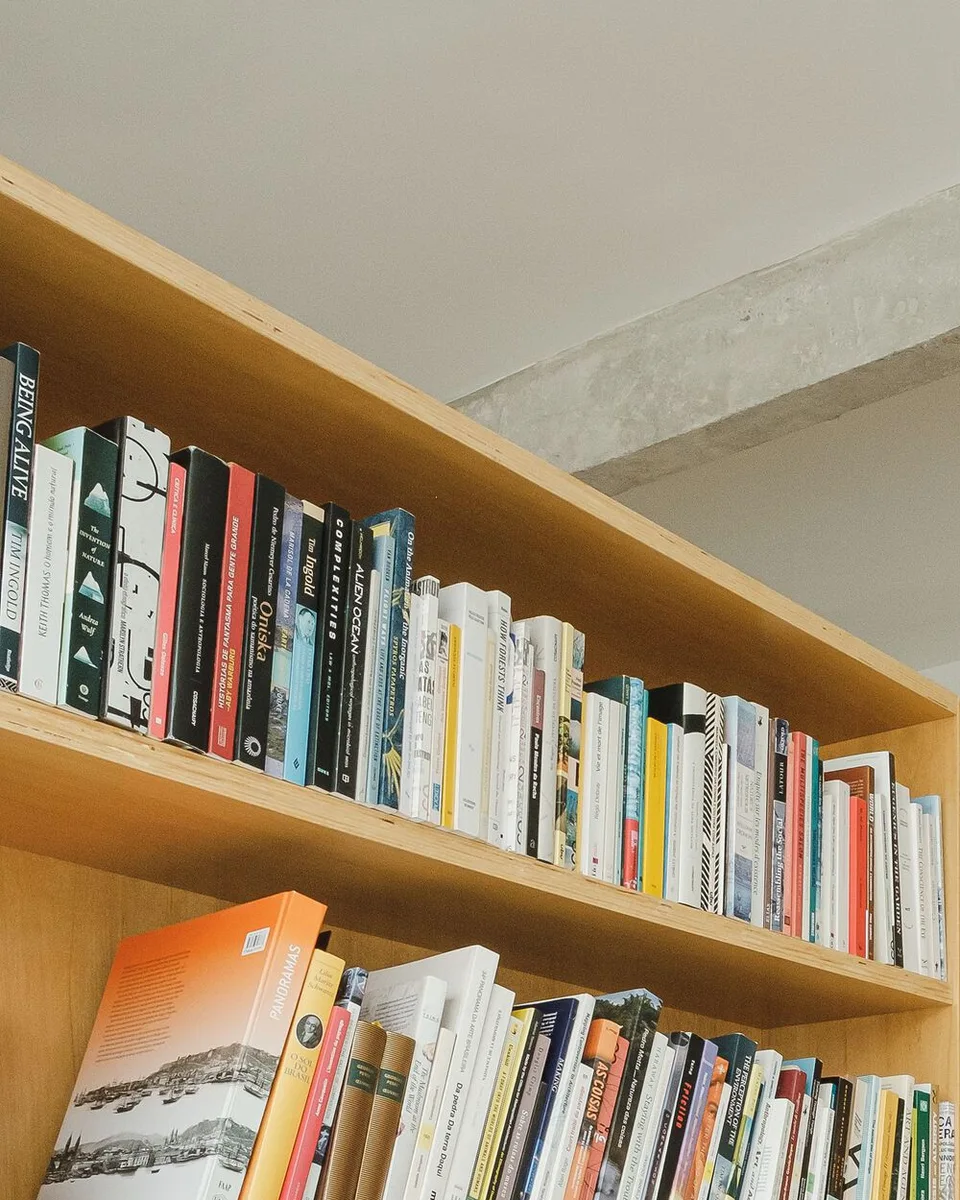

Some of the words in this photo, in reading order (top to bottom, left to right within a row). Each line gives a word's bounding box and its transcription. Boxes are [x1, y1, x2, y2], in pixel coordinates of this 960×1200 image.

[13, 367, 37, 437] BEING
[10, 437, 31, 501] ALIVE
[270, 505, 279, 525] Pedro
[9, 531, 23, 557] TIM
[230, 515, 239, 550] GRANDE
[269, 526, 277, 535] de
[306, 537, 315, 553] Tim
[405, 530, 415, 546] On
[266, 535, 277, 567] Niemeyer
[286, 530, 295, 562] MARISOL
[404, 547, 413, 562] the
[227, 551, 237, 578] GENTE
[285, 563, 293, 573] DE
[302, 553, 317, 596] Ingold
[327, 517, 344, 640] COMPLEXITIES
[4, 558, 21, 621] INGOLD
[225, 579, 234, 602] PARA
[266, 567, 274, 596] Cesarino
[284, 574, 292, 586] LA
[352, 562, 364, 605] ALIEN
[249, 595, 259, 621] poética
[282, 586, 291, 619] CADENA
[117, 619, 127, 643] MARILYN
[221, 602, 233, 648] FANTASMA
[249, 622, 256, 630] do
[254, 600, 275, 662] Oniska
[349, 606, 362, 655] OCEAN
[400, 622, 409, 637] the
[498, 619, 508, 641] HOW
[115, 643, 125, 673] STRATHERN
[221, 648, 229, 660] DE
[247, 631, 255, 668] xamanismo
[390, 635, 398, 664] SPYROS
[397, 638, 408, 679] Inorganic
[496, 642, 507, 683] FORESTS
[216, 660, 228, 708] HISTÓRIAS
[246, 669, 253, 678] na
[244, 678, 253, 710] amazônia
[387, 666, 396, 717] PAPAPETROS
[495, 684, 505, 713] THINK
[753, 770, 762, 802] Enquête
[889, 781, 897, 839] EUGENICS
[753, 829, 761, 852] modes
[775, 817, 783, 845] Social
[774, 845, 782, 860] the
[892, 843, 898, 855] IN
[752, 852, 760, 895] d'existence
[773, 862, 783, 921] Reassembling
[894, 885, 902, 935] GARDEN
[267, 942, 303, 1021] PANORAMAS
[638, 1026, 649, 1049] Pedro
[593, 1060, 610, 1079] AS
[633, 1048, 644, 1071] Motta
[646, 1045, 663, 1089] HARAWAY
[741, 1054, 752, 1071] THE
[454, 1081, 464, 1094] Da
[549, 1056, 565, 1093] MAKING
[446, 1093, 460, 1119] pedra
[583, 1078, 606, 1122] COISAS
[624, 1077, 638, 1111] Natureza
[673, 1080, 693, 1129] Friction
[724, 1067, 742, 1126] ENVIRONMENT
[732, 1070, 749, 1117] PERCEPTION
[445, 1118, 455, 1131] Da
[621, 1110, 630, 1124] das
[636, 1092, 653, 1131] Staying
[730, 1116, 740, 1130] OF
[904, 1108, 912, 1135] ART
[440, 1131, 451, 1152] terra
[615, 1123, 627, 1148] coisas
[631, 1130, 644, 1155] with
[727, 1129, 737, 1147] THE
[434, 1151, 448, 1178] Daqui
[627, 1155, 639, 1173] the
[901, 1137, 910, 1169] AND
